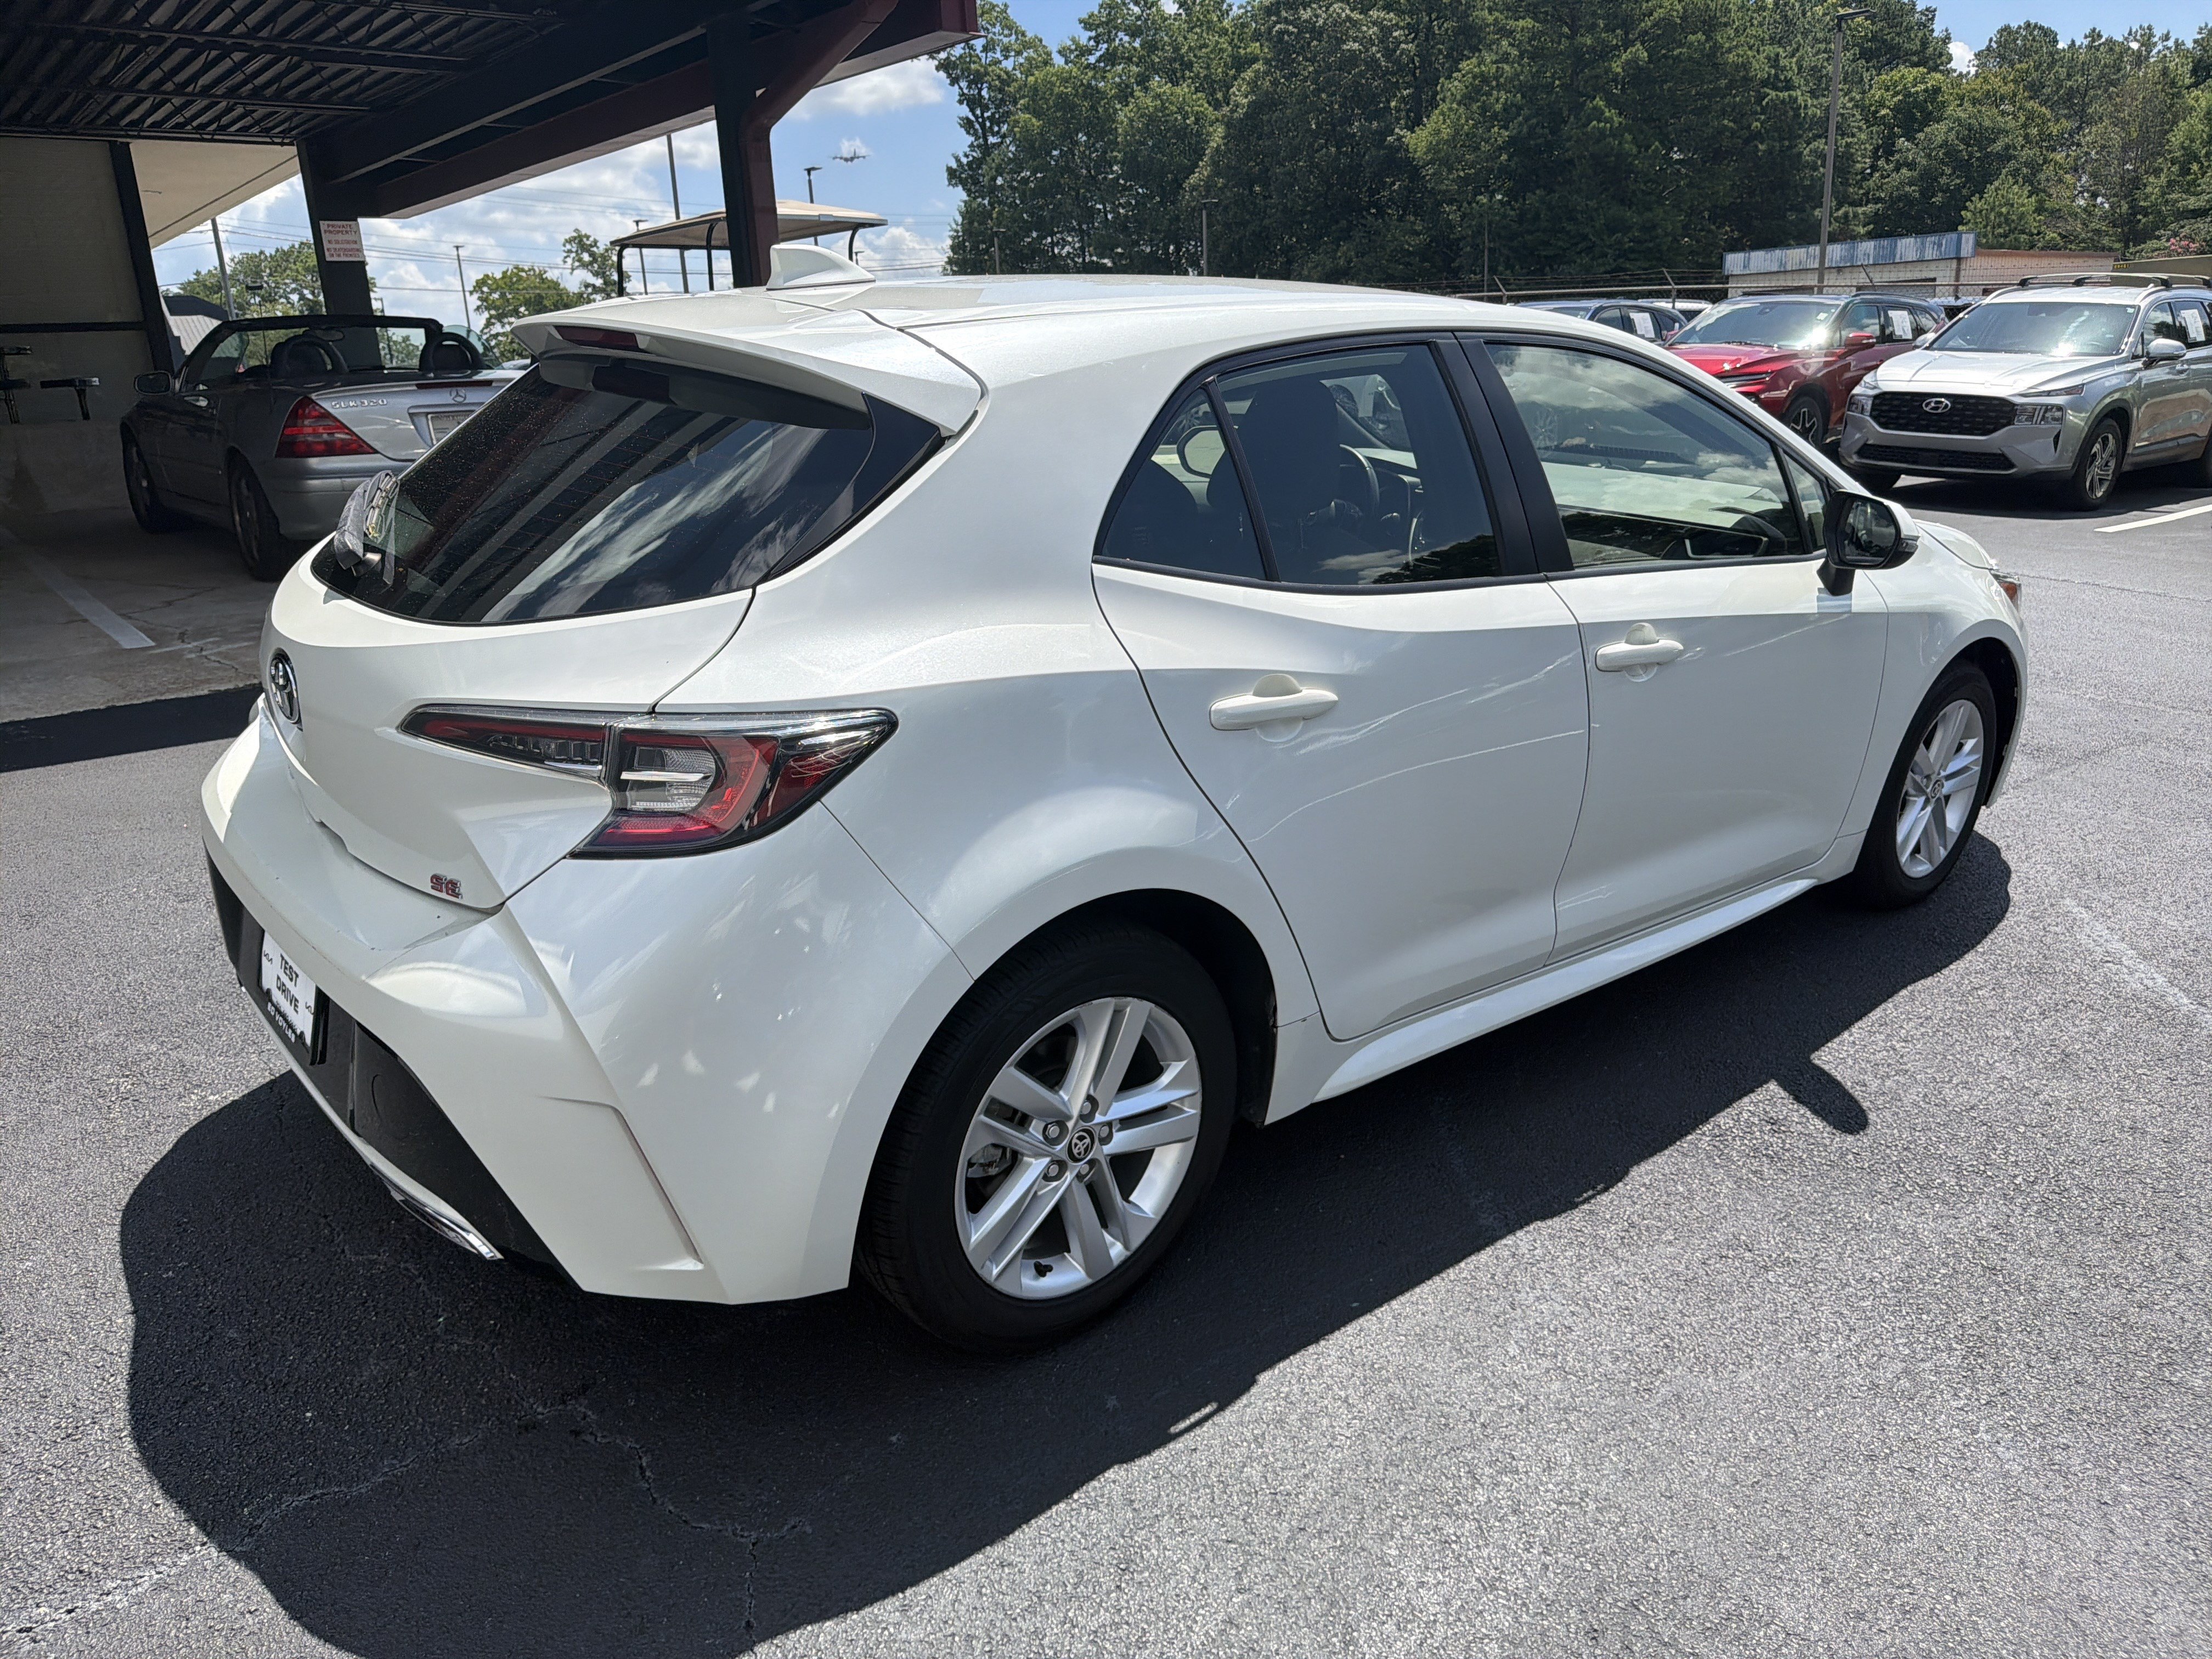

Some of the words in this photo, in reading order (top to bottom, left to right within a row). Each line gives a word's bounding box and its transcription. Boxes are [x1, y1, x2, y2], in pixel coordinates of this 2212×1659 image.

[331, 400, 358, 409] SLK
[360, 398, 388, 408] 320
[430, 873, 463, 900] SE
[279, 953, 299, 988] TEST
[276, 974, 300, 1015] DRIVE
[267, 1001, 275, 1016] ED
[275, 1011, 296, 1043] VOYLES
